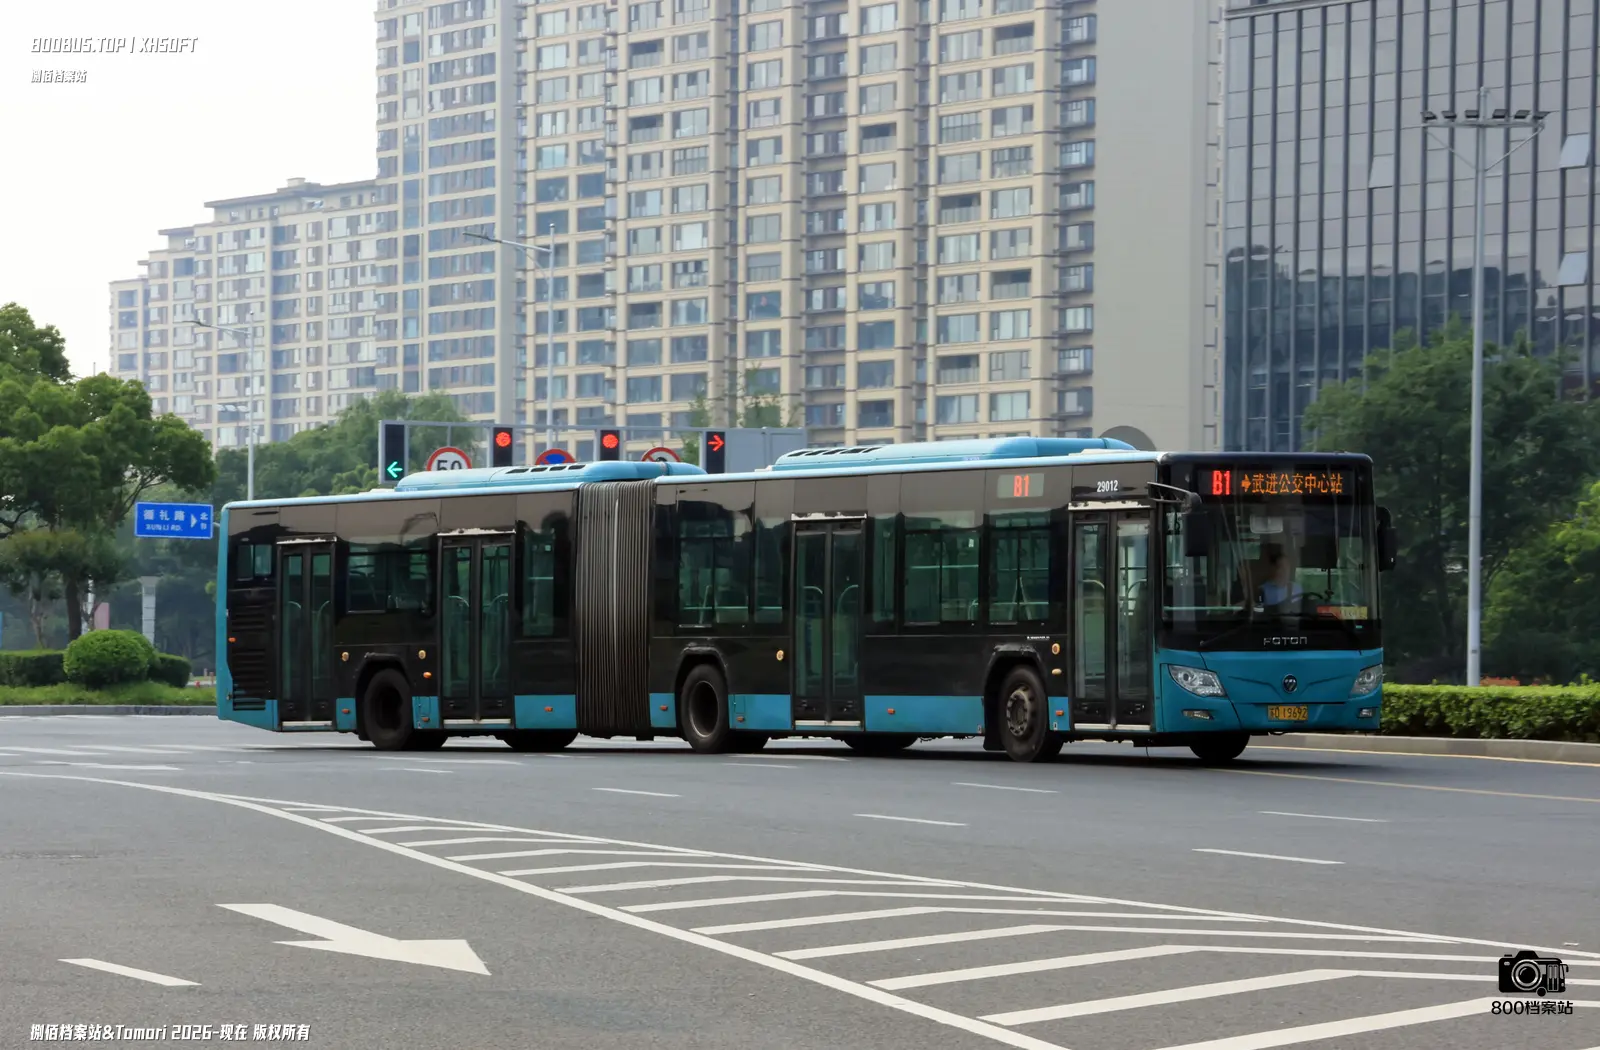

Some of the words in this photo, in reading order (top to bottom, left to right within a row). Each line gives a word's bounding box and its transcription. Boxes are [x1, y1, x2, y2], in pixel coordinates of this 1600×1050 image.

[1013, 475, 1030, 497] B1
[1097, 480, 1119, 493] 29012
[1212, 470, 1231, 495] B1
[1251, 473, 1343, 494] 武进公交中心站
[1263, 636, 1308, 646] FOTON
